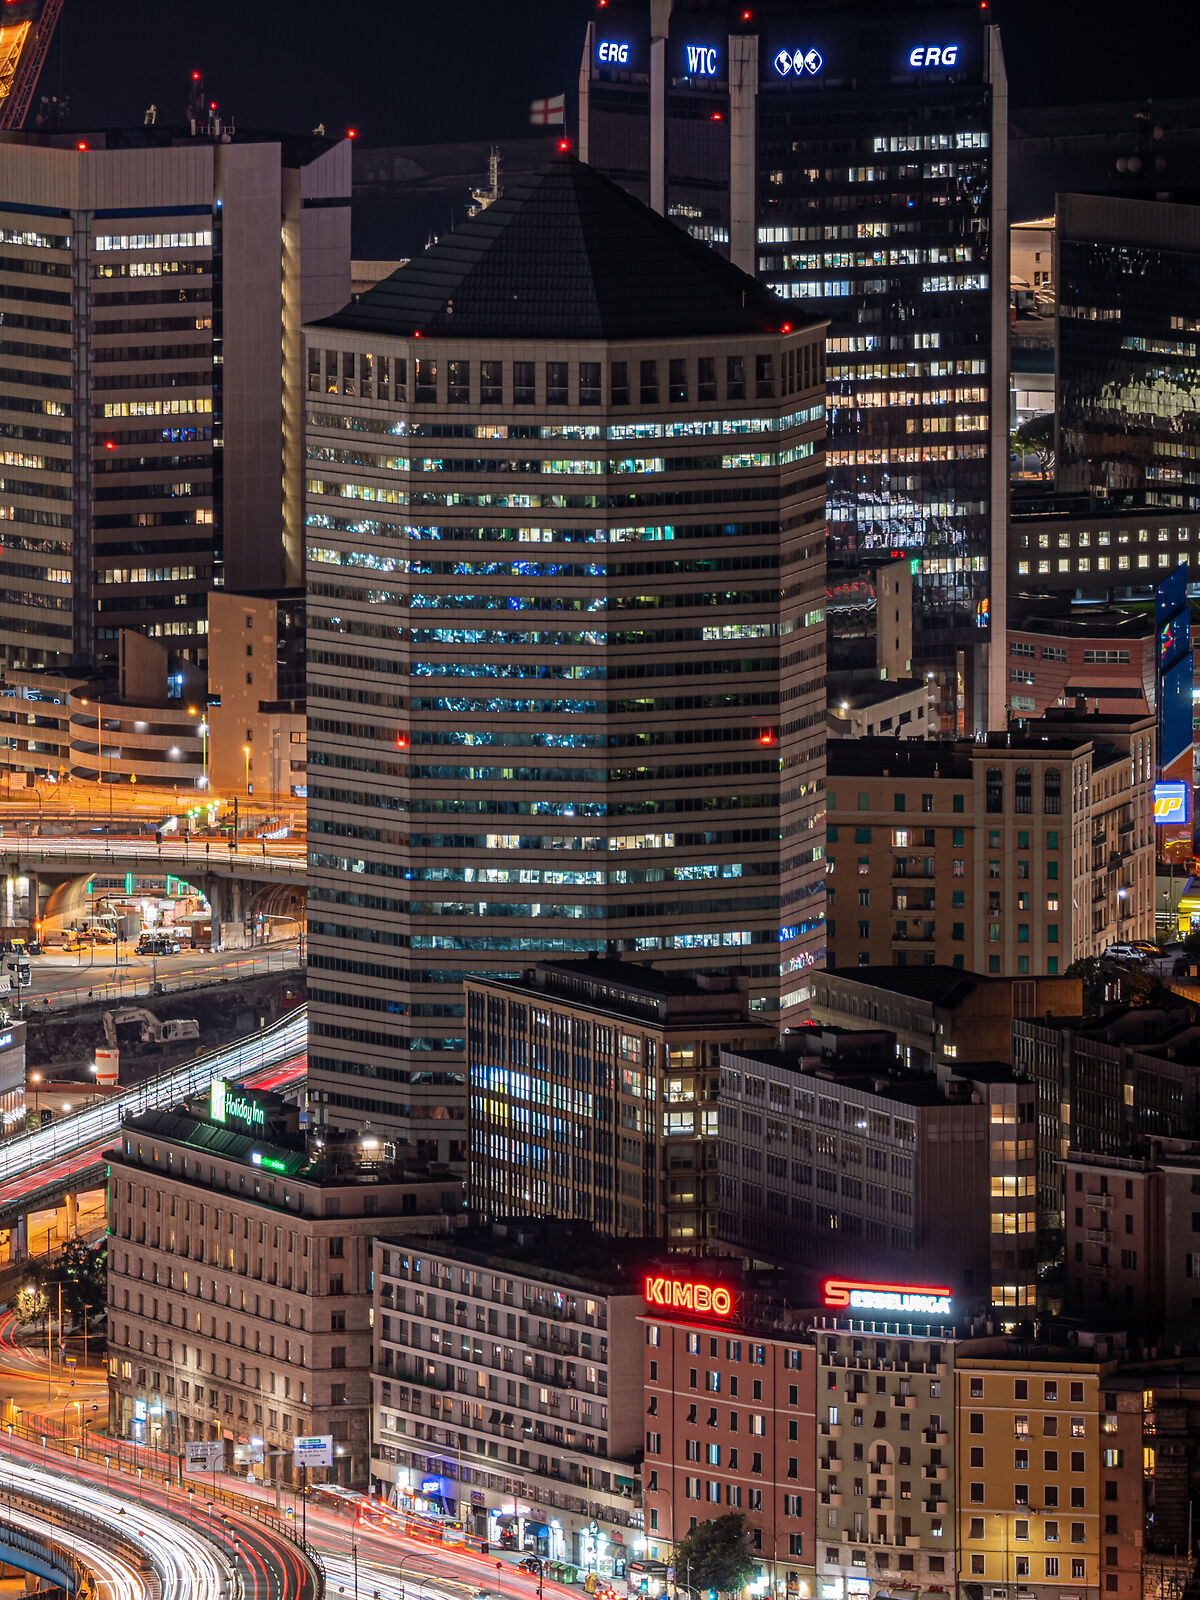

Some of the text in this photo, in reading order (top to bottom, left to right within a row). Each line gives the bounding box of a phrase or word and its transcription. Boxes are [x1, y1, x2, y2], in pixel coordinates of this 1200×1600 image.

[599, 42, 628, 63] ERG
[687, 46, 717, 75] WTC
[910, 46, 958, 67] ERG
[225, 1092, 265, 1126] Holiday Inn
[645, 1277, 731, 1315] KIMBO
